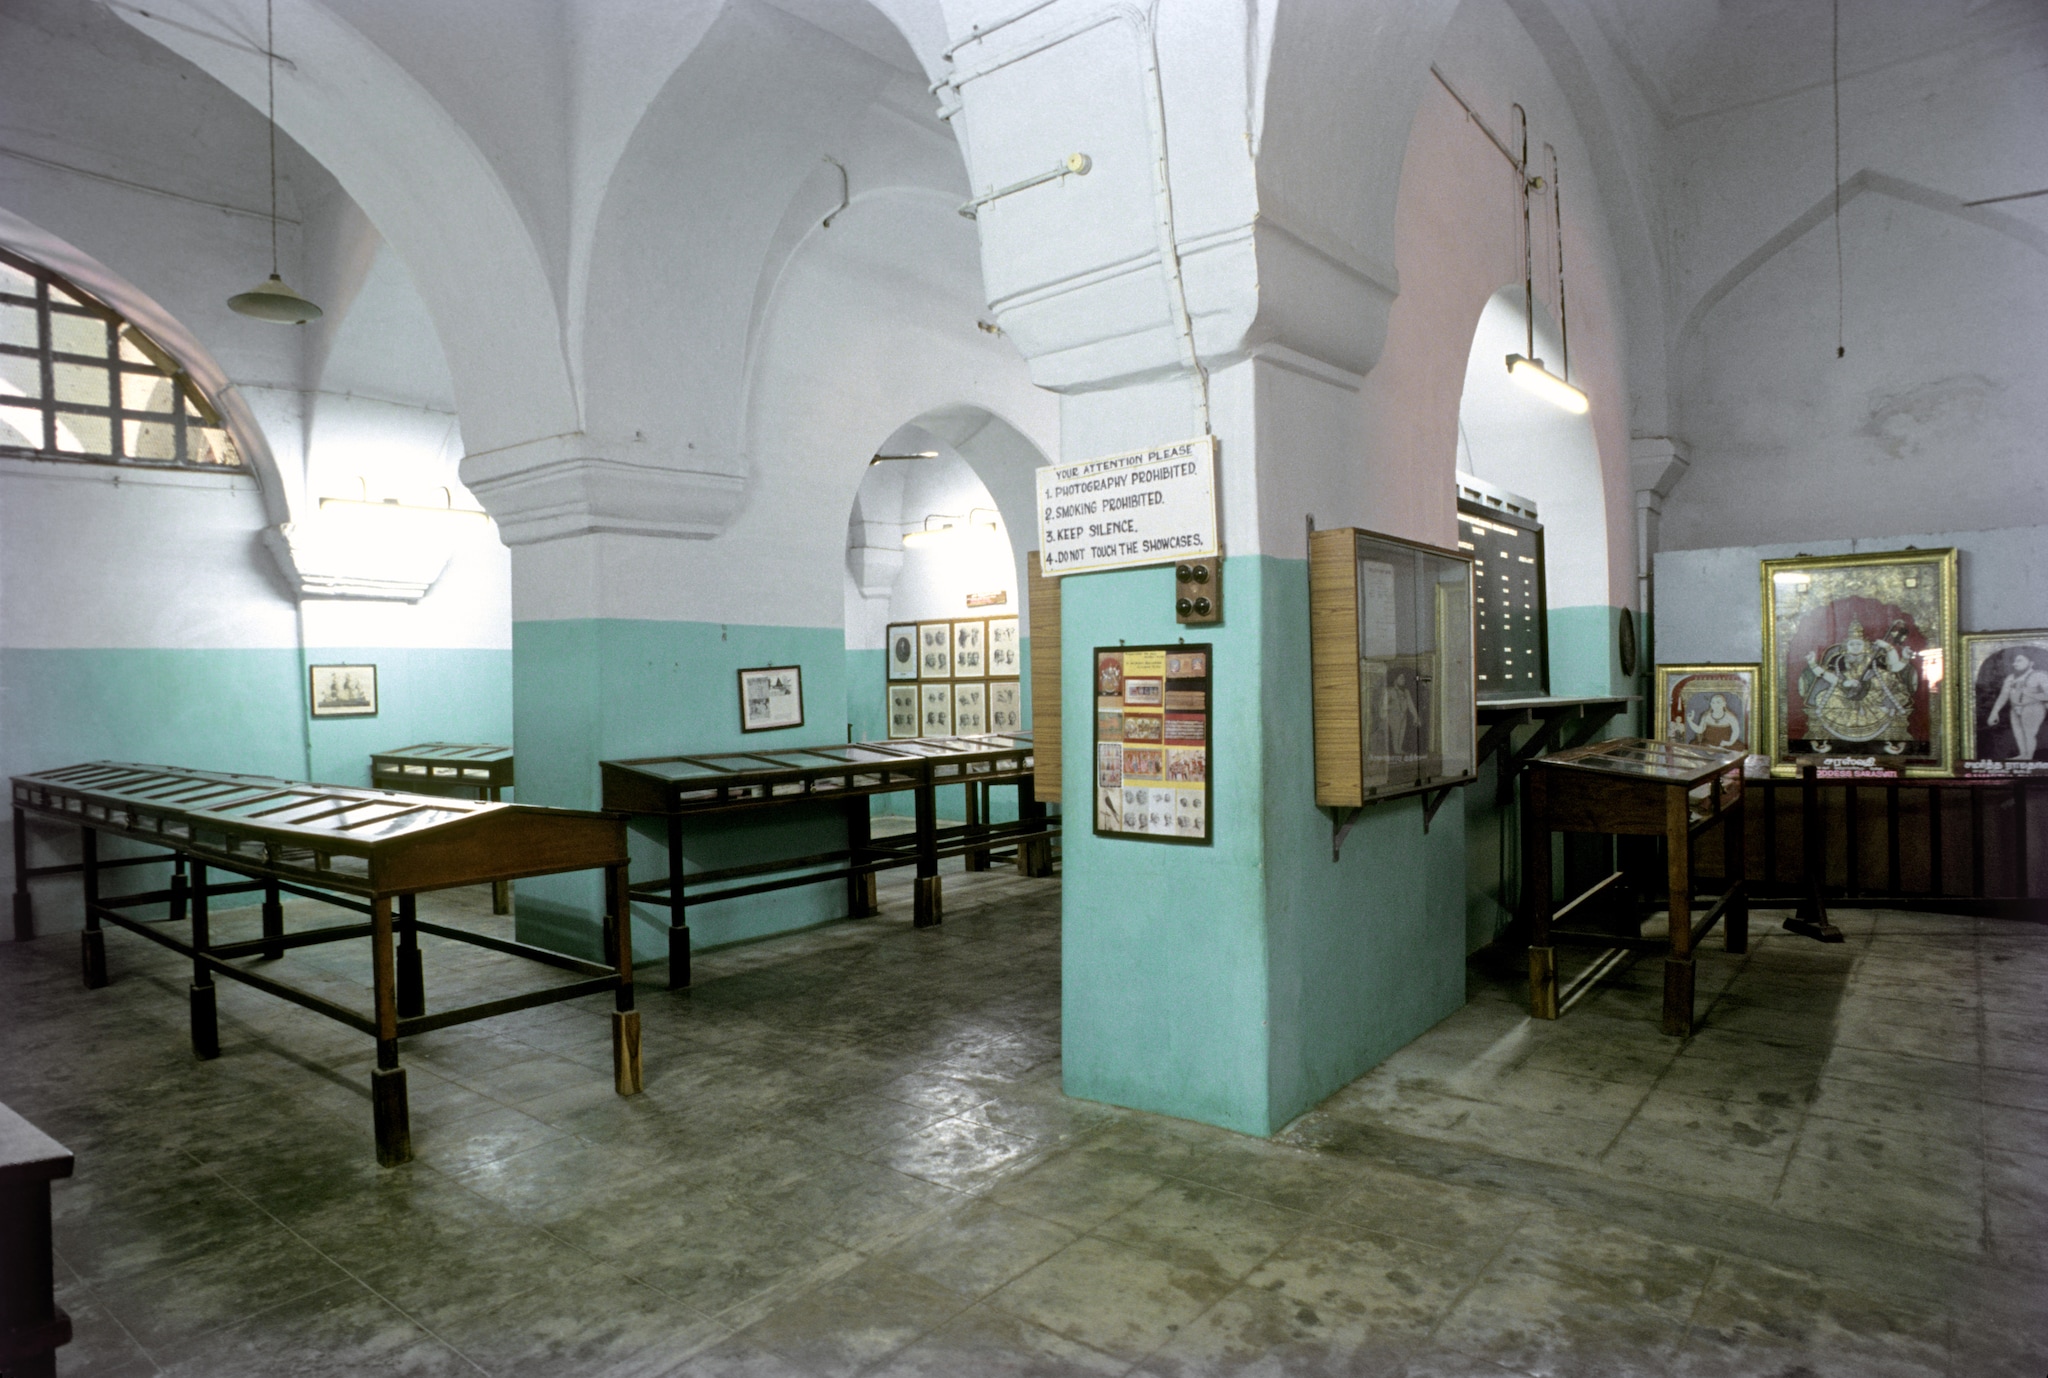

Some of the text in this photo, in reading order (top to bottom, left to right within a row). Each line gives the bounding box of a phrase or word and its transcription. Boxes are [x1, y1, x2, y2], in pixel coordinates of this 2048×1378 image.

[1056, 445, 1192, 480] YOUR ATTENTION PLEASE
[1045, 462, 1197, 499] 1. PHOTOGRAPHY PROHIBITED.
[1045, 491, 1164, 521] 2. SMOKING PROHIBITED.
[1046, 520, 1138, 542] 3. KEEP SILENCE.
[1092, 544, 1117, 559] TOUCH
[1119, 541, 1138, 555] THE
[1143, 533, 1203, 552] SHOWCASES.
